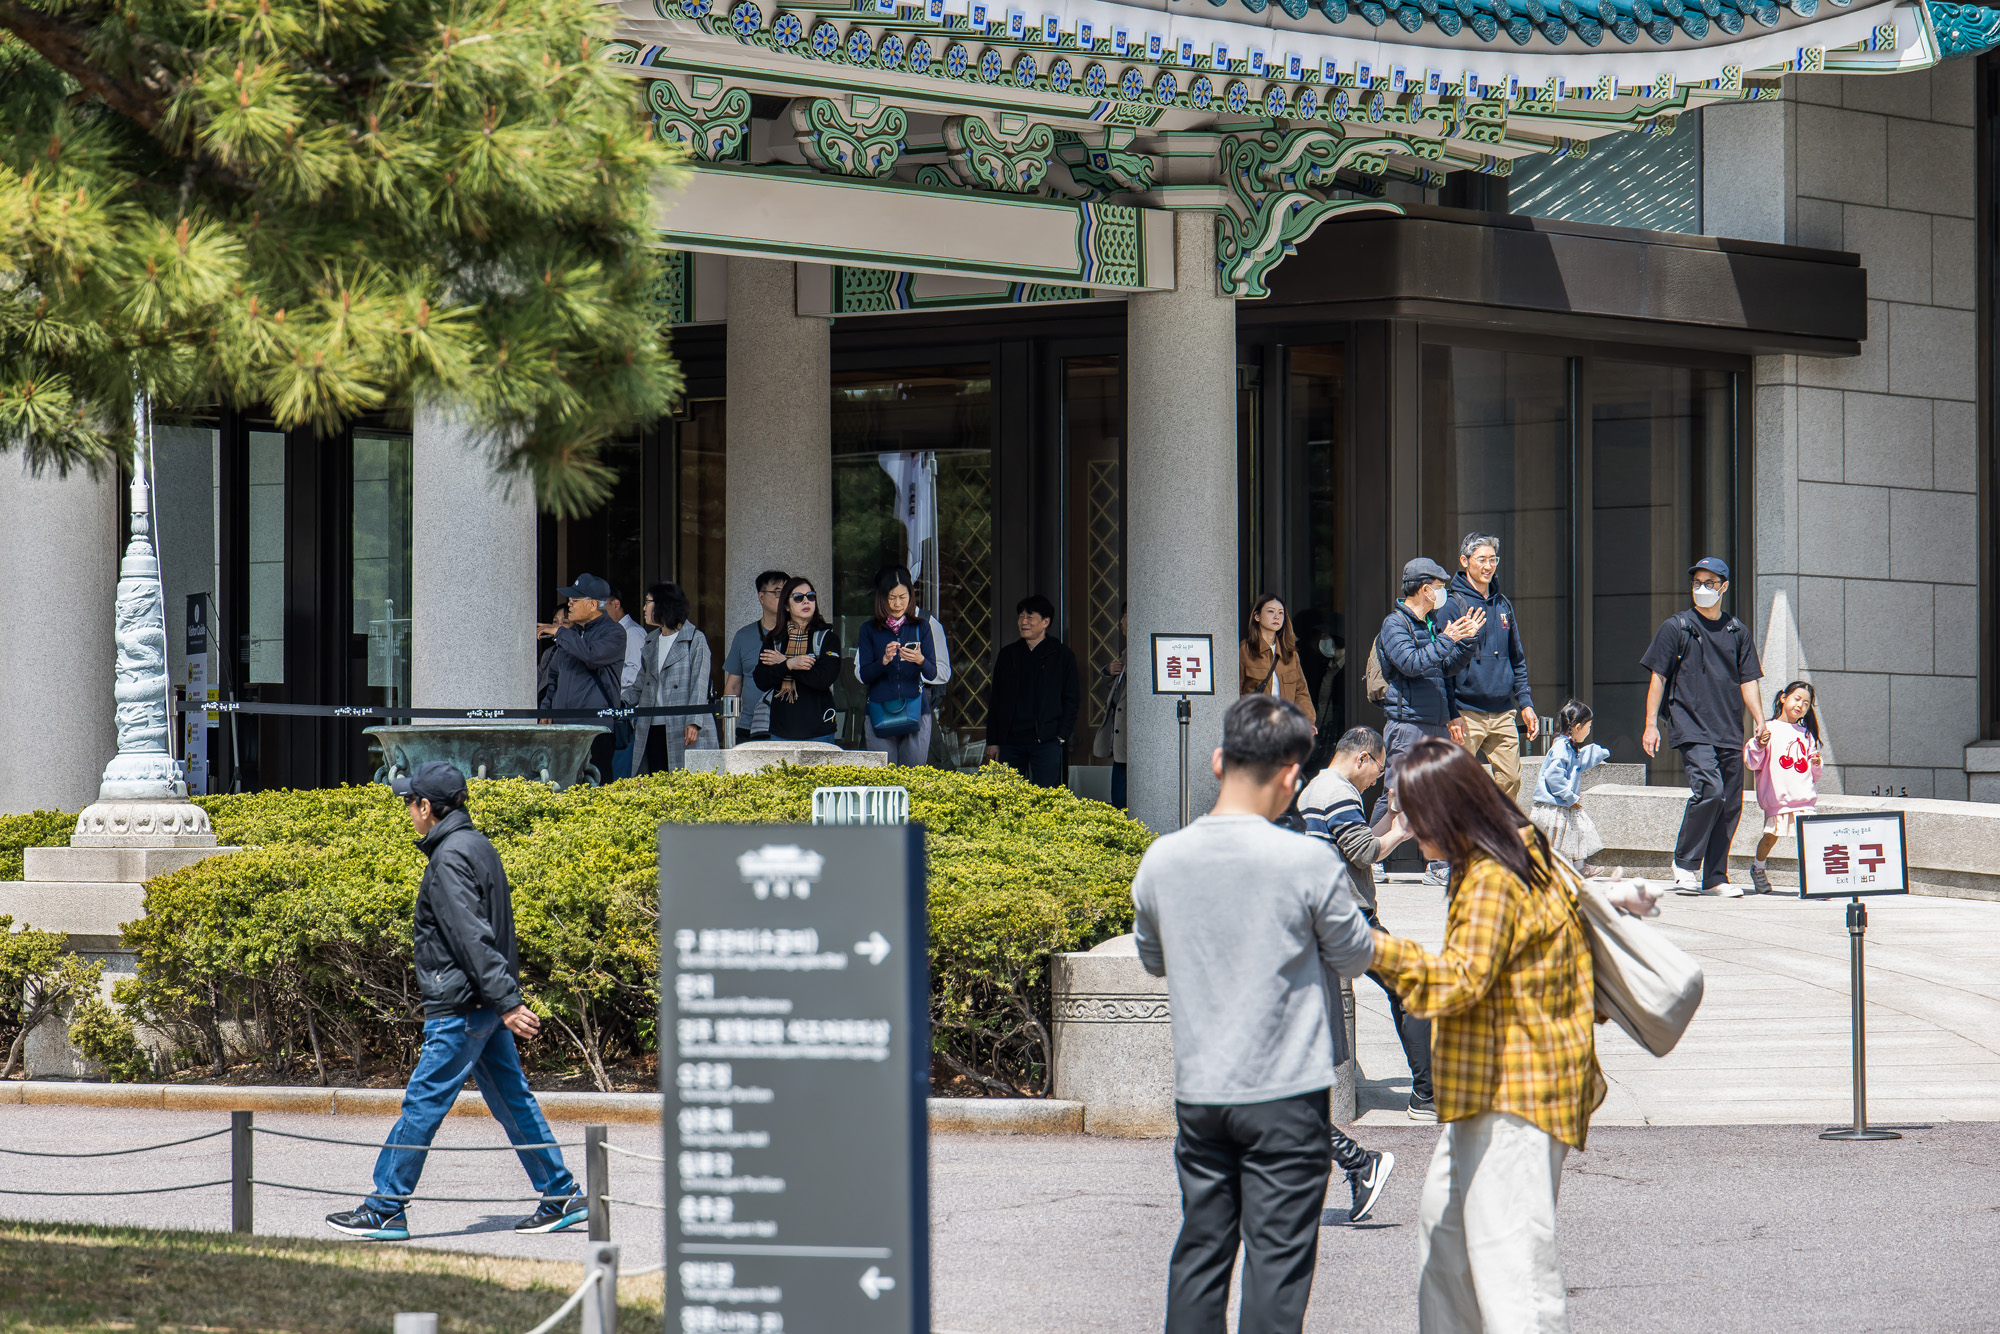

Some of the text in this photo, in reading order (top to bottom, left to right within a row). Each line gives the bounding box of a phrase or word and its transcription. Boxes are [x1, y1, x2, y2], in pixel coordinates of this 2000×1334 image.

[1166, 655, 1202, 679] 출구
[1822, 843, 1886, 875] 출구
[1836, 876, 1849, 884] Exit
[1860, 875, 1876, 884] 出口
